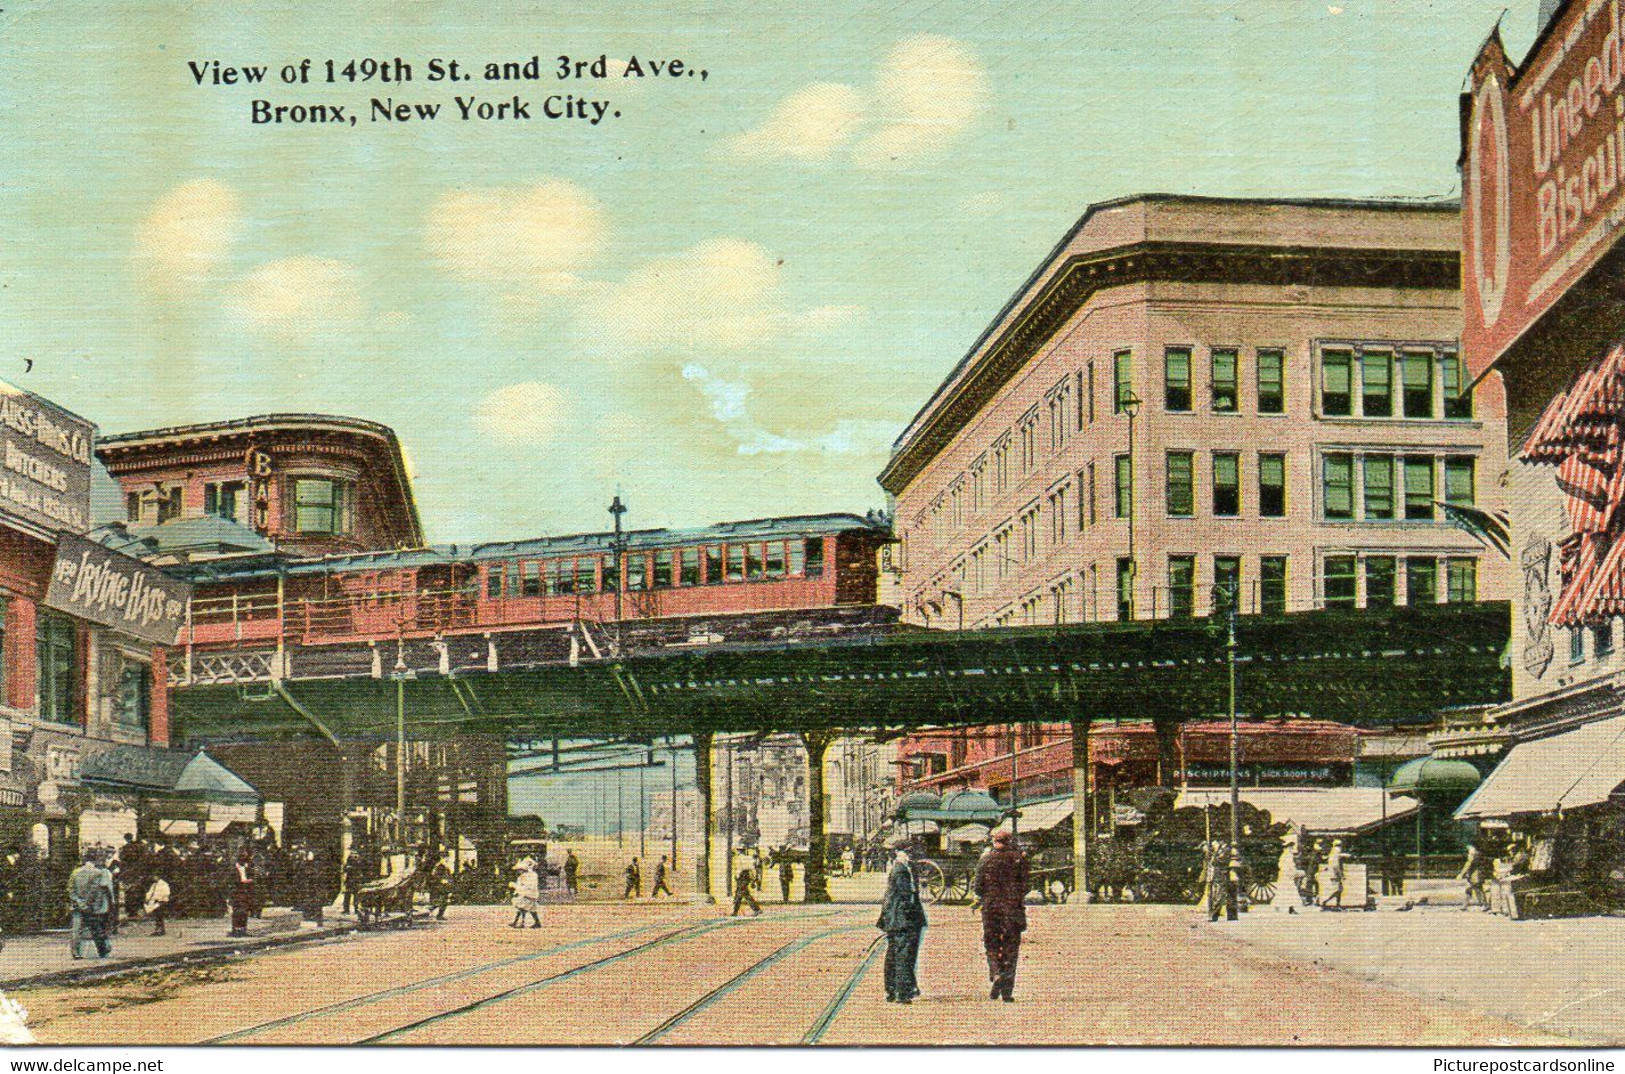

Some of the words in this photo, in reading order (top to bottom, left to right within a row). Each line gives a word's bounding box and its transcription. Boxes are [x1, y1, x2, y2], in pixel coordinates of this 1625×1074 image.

[188, 60, 267, 84] View
[282, 58, 311, 83] of
[325, 57, 412, 82] 149th
[427, 58, 471, 82] St.
[484, 55, 540, 80] and
[556, 54, 607, 79] 3rd
[623, 55, 708, 80] Ave.,
[1532, 0, 1625, 174] Uneed
[251, 100, 357, 127] Bronx,
[371, 97, 441, 122] New
[454, 95, 530, 120] York
[543, 94, 621, 126] City.
